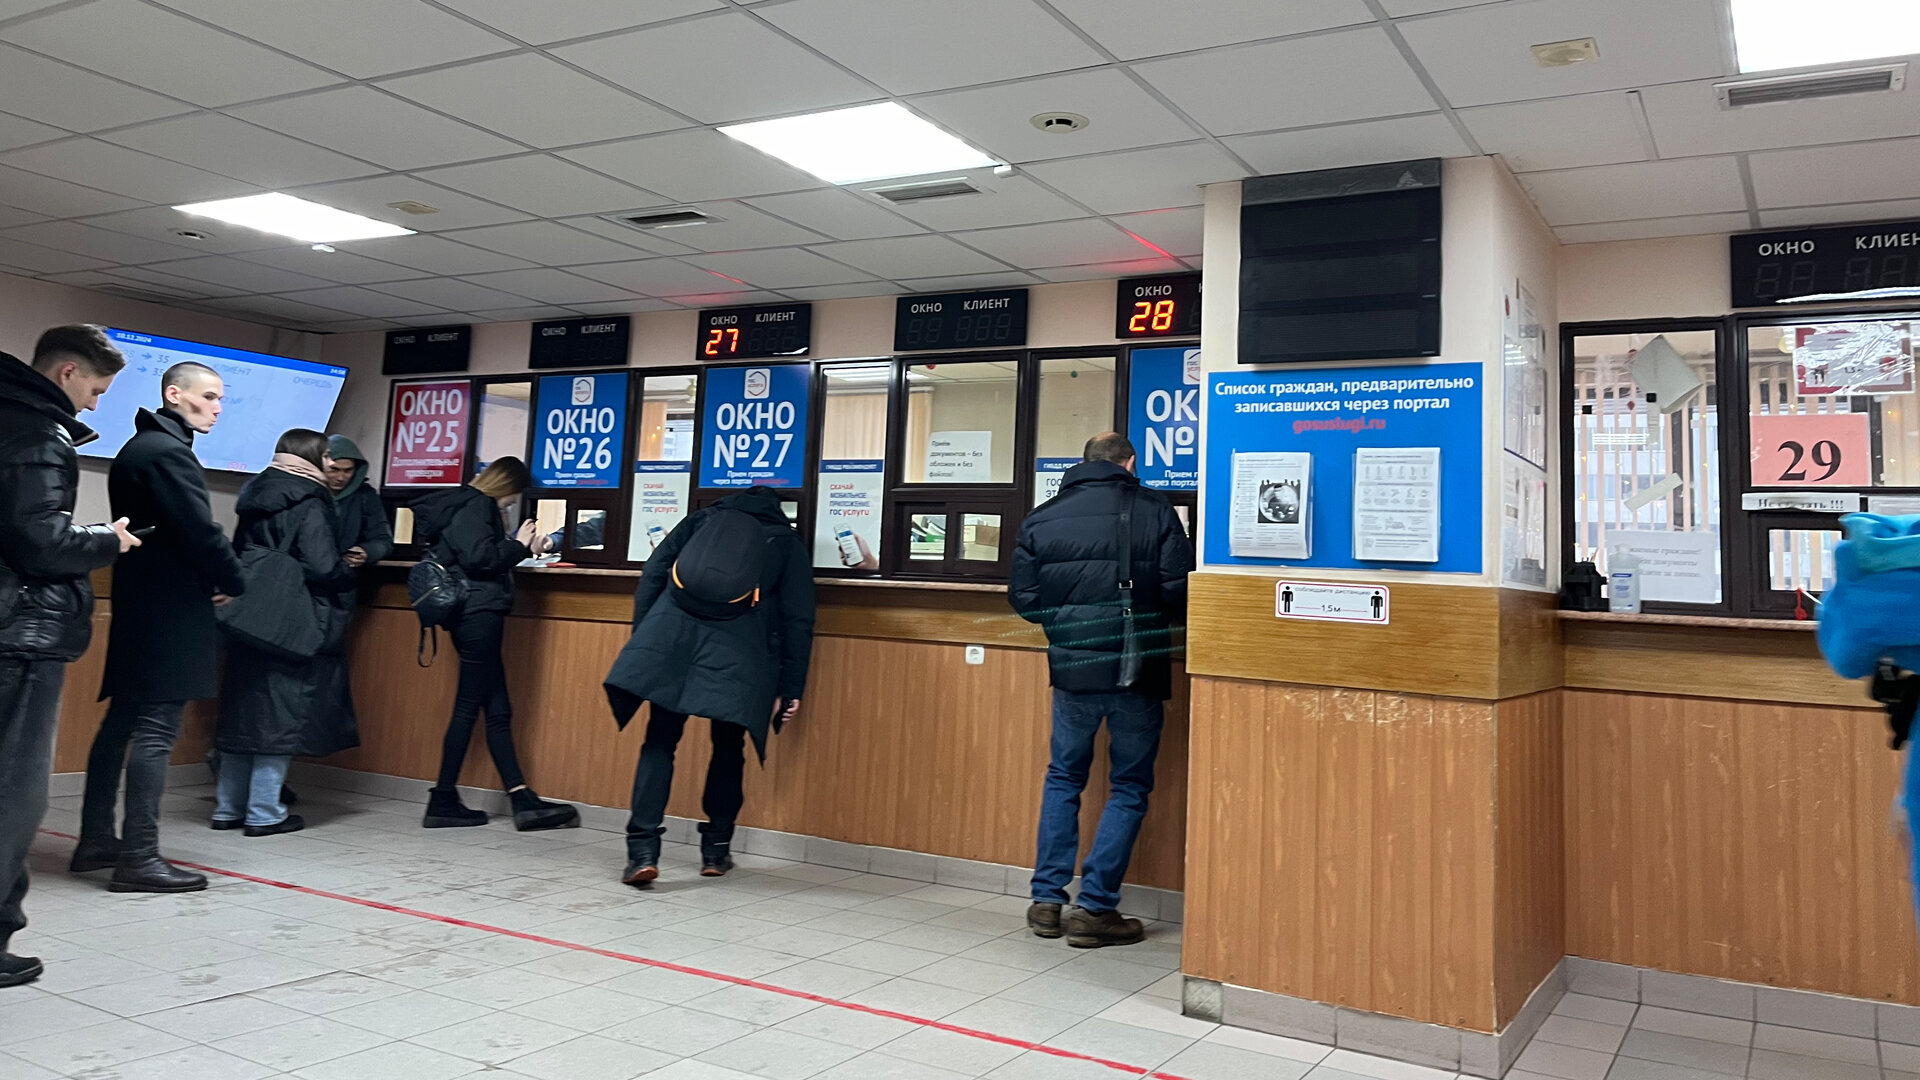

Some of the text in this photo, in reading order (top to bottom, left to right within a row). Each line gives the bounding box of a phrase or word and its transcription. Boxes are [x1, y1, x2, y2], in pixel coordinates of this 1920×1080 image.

[1758, 232, 1920, 256] ОКНО КЛИЕН
[1134, 285, 1172, 297] ОКНО
[710, 311, 796, 325] ОКНО КЛИЕНТ
[911, 298, 1010, 314] ОКНО КЛИЕНТ
[1129, 300, 1175, 332] 28
[705, 328, 739, 355] 27
[1214, 377, 1474, 397] Список граждан, предварительно
[400, 389, 463, 416] ОКНО
[716, 401, 795, 430] ОКНО
[1145, 389, 1199, 423] ОК
[1234, 397, 1450, 414] записавшихся через портал
[547, 407, 615, 435] ОКНО
[1292, 416, 1386, 434] gosuslugi.ru
[396, 420, 460, 453] №25
[543, 437, 612, 470] №26
[713, 433, 794, 468] №27
[1777, 440, 1842, 482] 29
